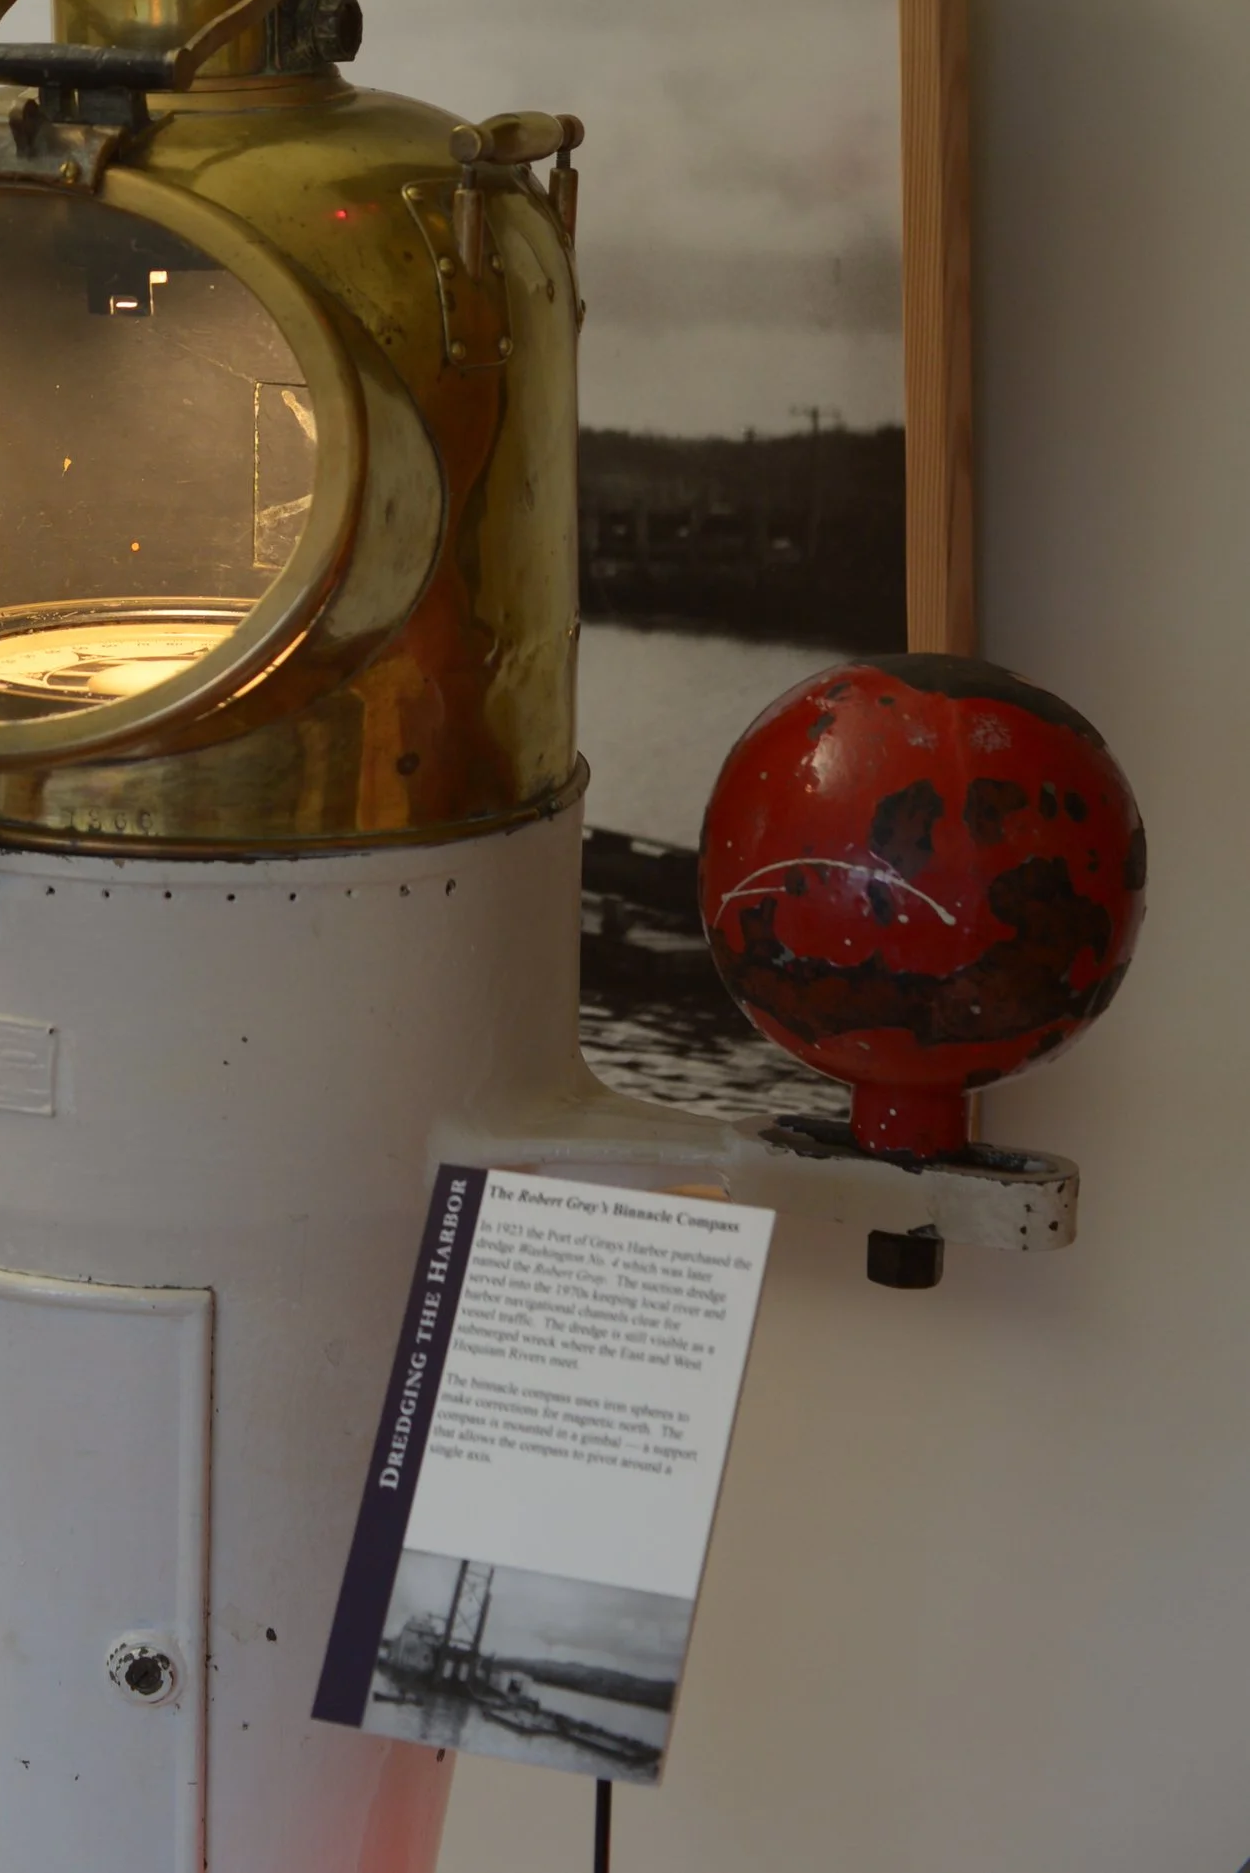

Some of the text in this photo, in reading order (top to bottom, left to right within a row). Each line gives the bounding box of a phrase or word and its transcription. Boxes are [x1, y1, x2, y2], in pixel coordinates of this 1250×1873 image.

[488, 1184, 514, 1200] The
[516, 1189, 563, 1208] Robert
[611, 1202, 673, 1224] Binnacle
[673, 1211, 741, 1237] Compass
[377, 1177, 468, 1490] DREDGING THE HARBOR
